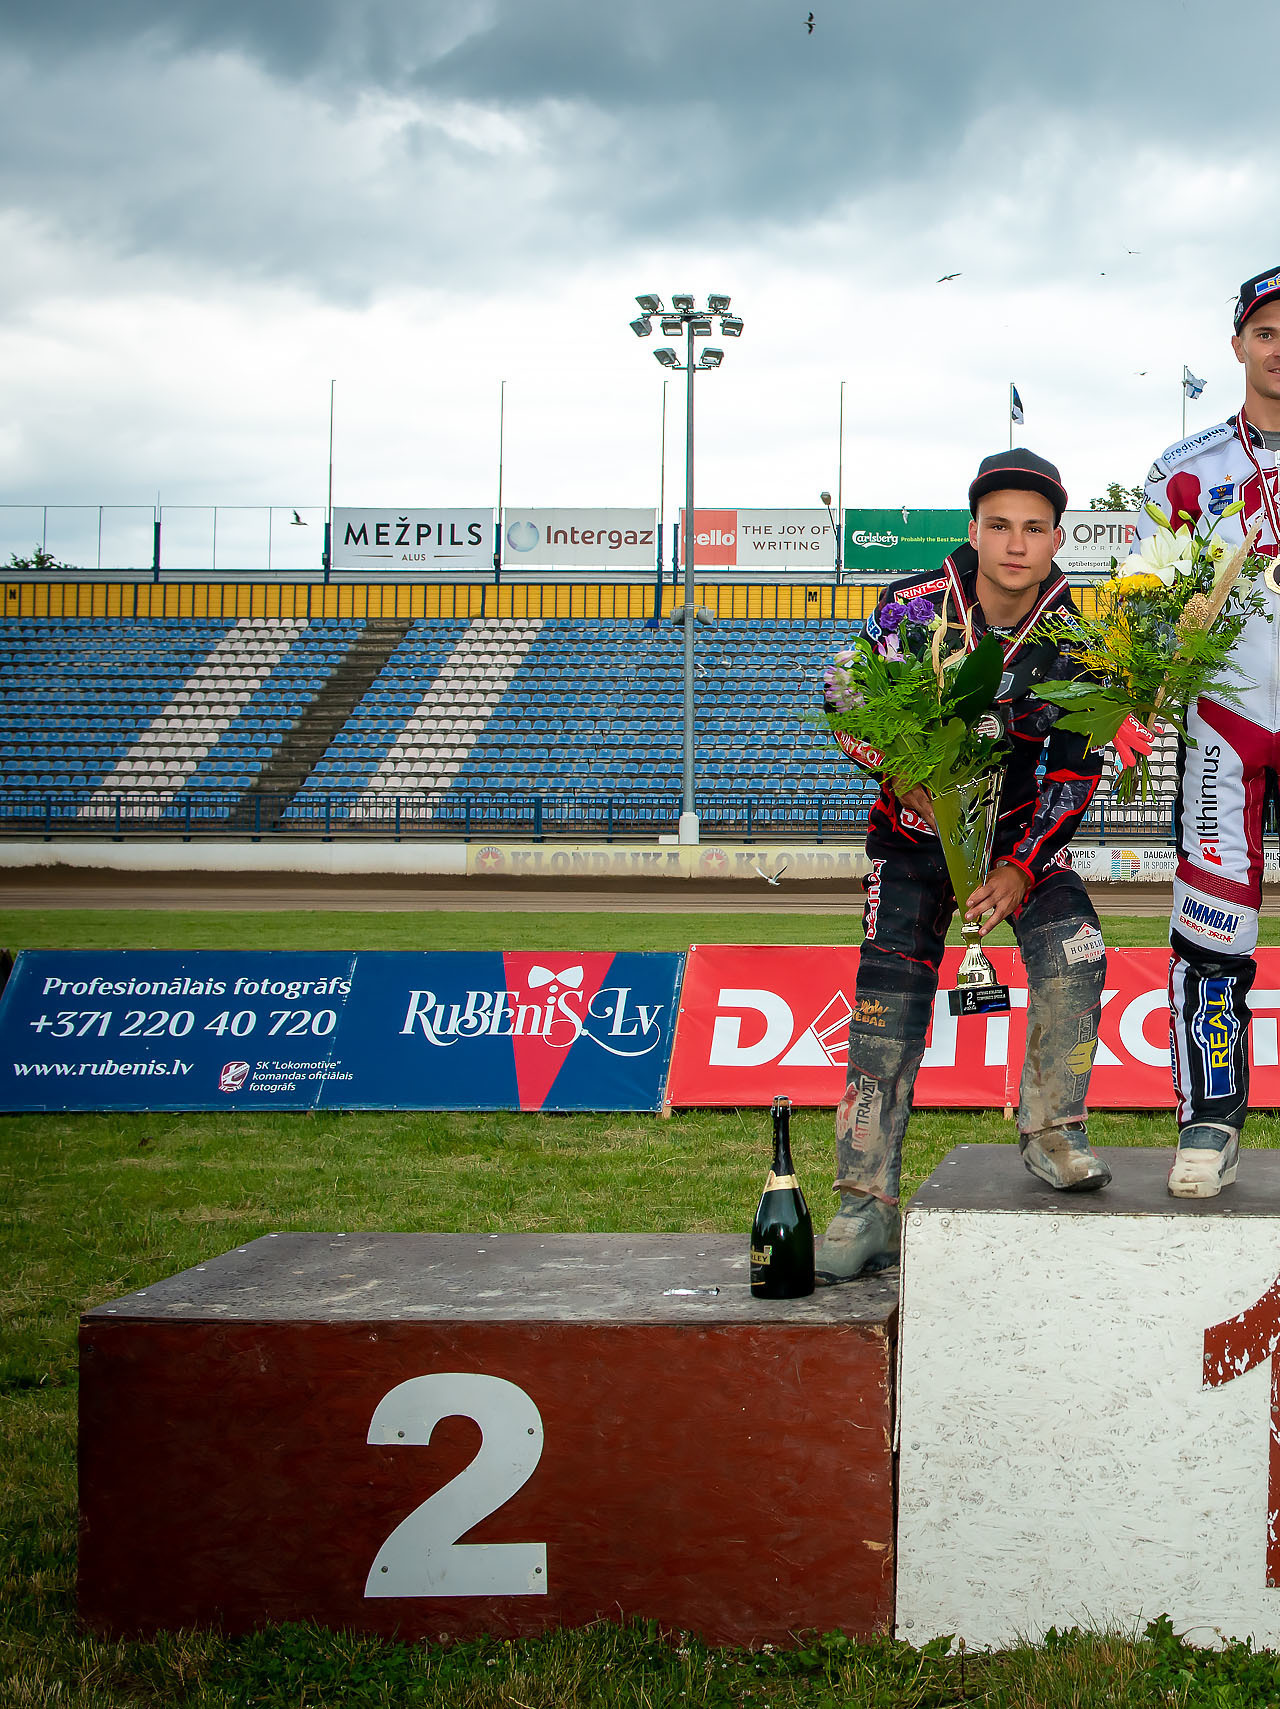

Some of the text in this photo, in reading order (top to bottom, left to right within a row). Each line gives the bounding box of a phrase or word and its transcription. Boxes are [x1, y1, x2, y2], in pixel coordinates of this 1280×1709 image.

[1163, 427, 1226, 462] CreditValue
[345, 516, 482, 546] MEŽPILS
[546, 525, 654, 550] Intergaz
[743, 525, 831, 535] THE JOY OF
[852, 530, 899, 548] Carlsberg
[1073, 524, 1136, 544] OPTIB
[753, 541, 821, 551] WRITING
[901, 536, 925, 544] Probably
[402, 553, 427, 562] ALUS
[807, 591, 818, 602] M
[1071, 850, 1096, 860] AVPILS
[1144, 849, 1177, 860] DAUGAVP
[1182, 896, 1240, 934] UMMBA!
[1179, 914, 1233, 944] ENERGY DRINK
[42, 976, 352, 999] Profesionālais fotogrāfs
[30, 1010, 338, 1038] +371 220 40 720
[13, 1058, 195, 1077] www.rubenis.lv
[256, 1060, 270, 1070] SK
[252, 1070, 354, 1081] komandas oficiālais
[249, 1081, 297, 1093] fotogrāfs
[364, 1371, 549, 1598] 2
